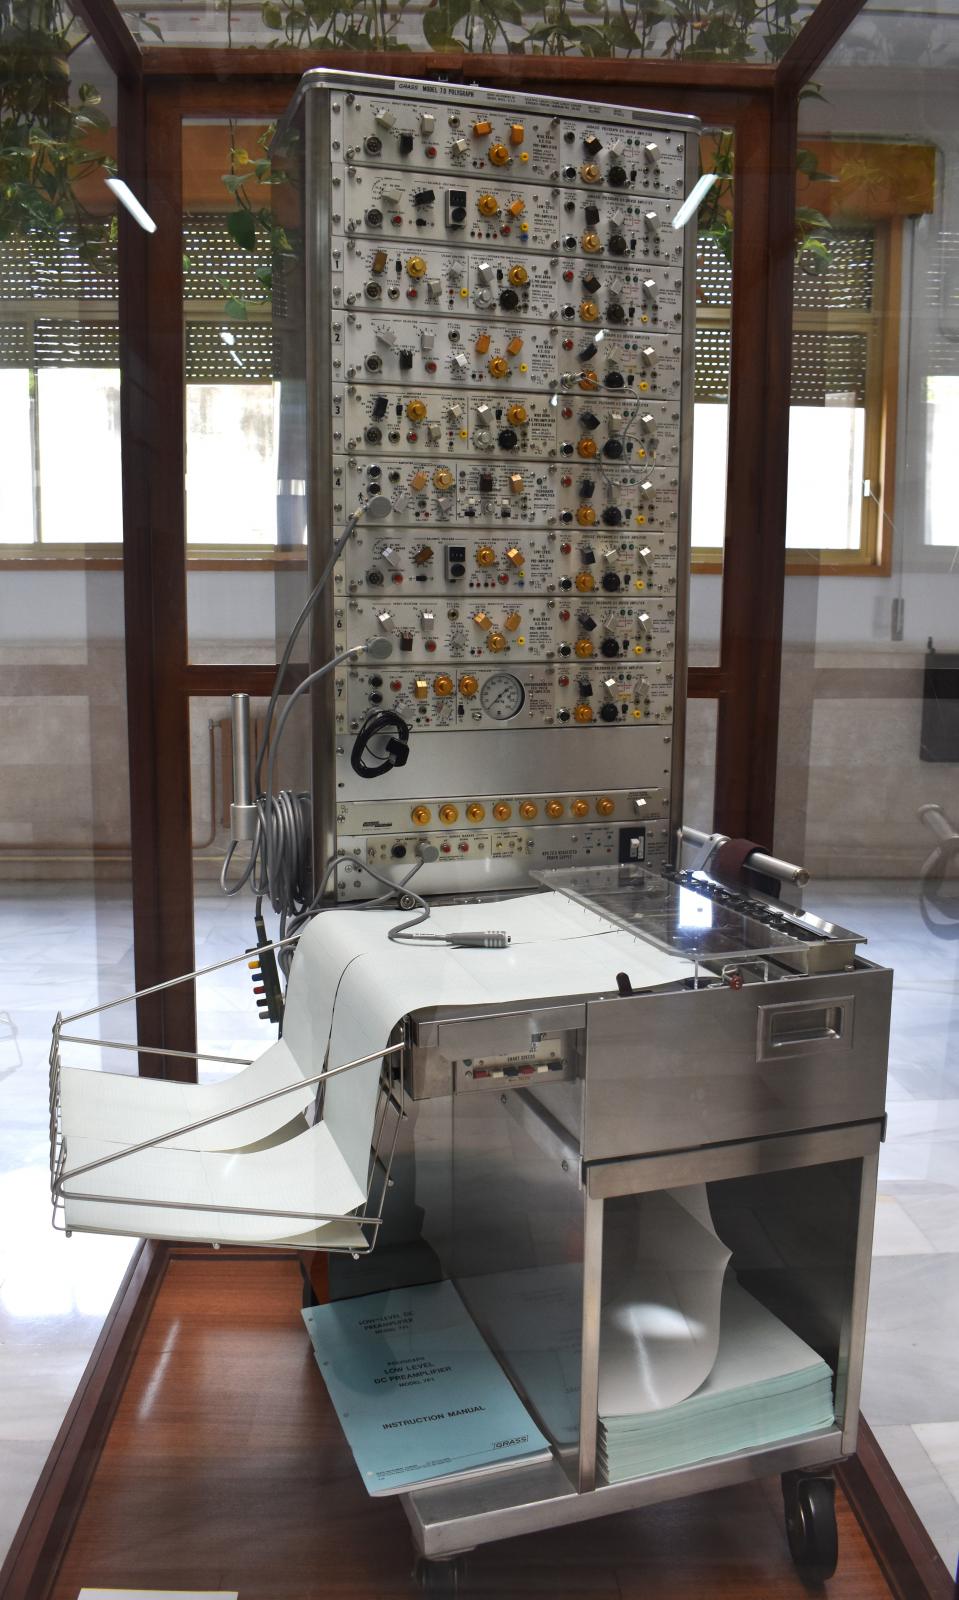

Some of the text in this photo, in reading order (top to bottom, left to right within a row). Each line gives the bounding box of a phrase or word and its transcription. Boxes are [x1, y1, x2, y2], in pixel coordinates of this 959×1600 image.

[422, 85, 438, 94] MODEL
[334, 333, 341, 343] 2
[335, 406, 341, 415] 3
[335, 478, 341, 487] 4
[336, 620, 342, 629] 6
[336, 689, 342, 698] 7
[384, 1362, 435, 1375] LOW LEVEL
[373, 1366, 453, 1385] DC PREAMPLIFIER
[382, 1404, 486, 1430] INSTRUCTION MANUAL
[494, 1435, 528, 1450] GRASS
